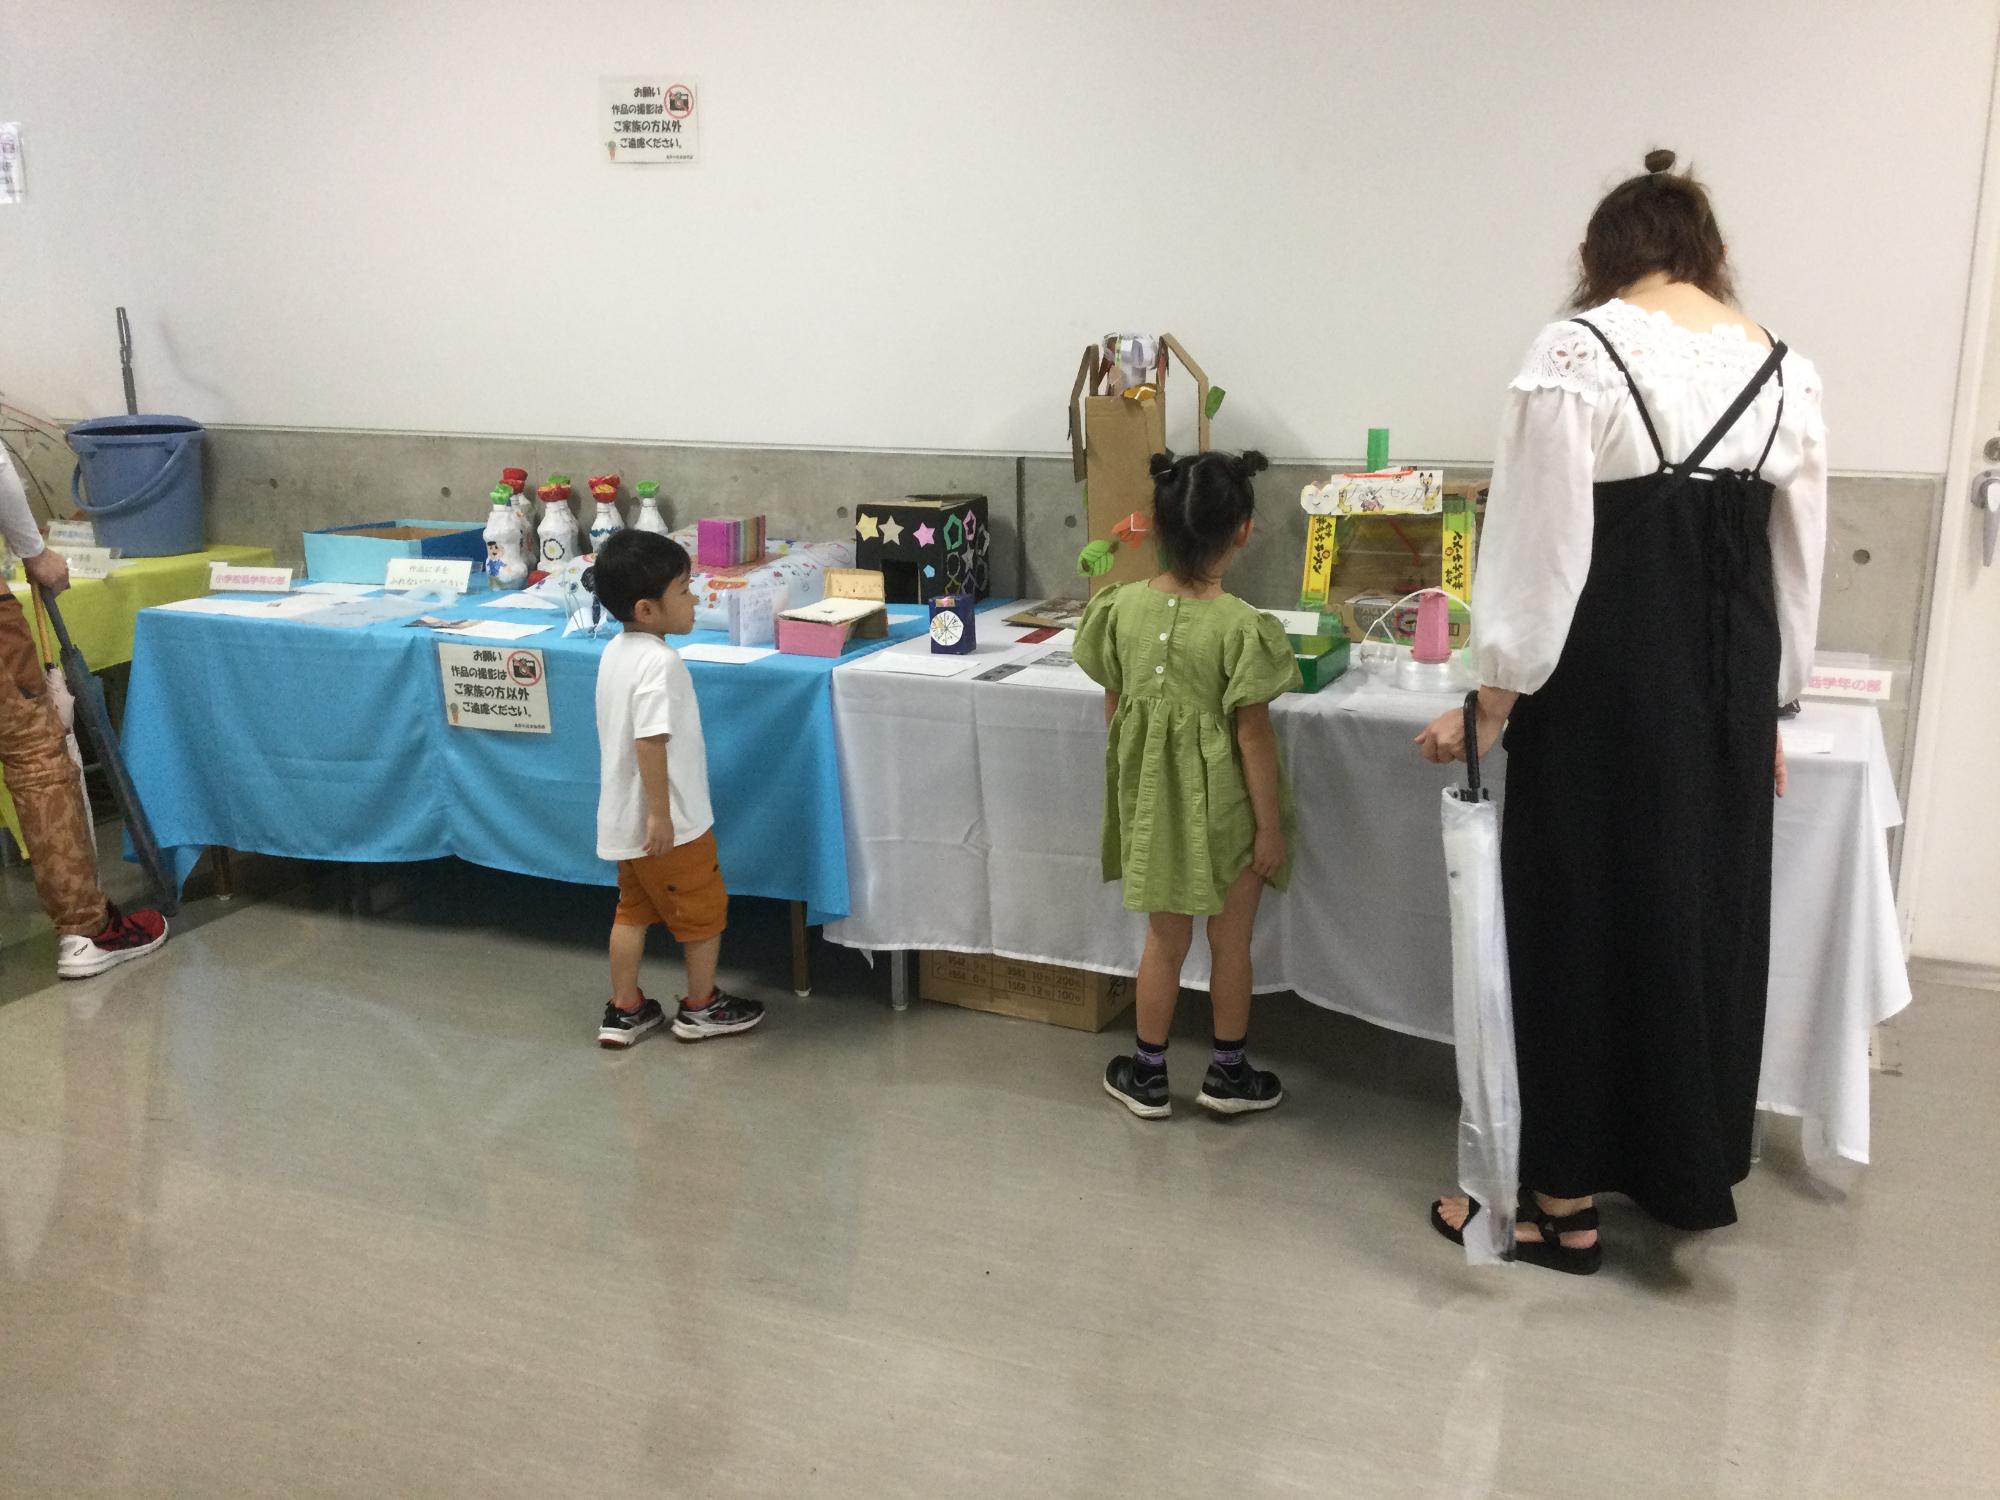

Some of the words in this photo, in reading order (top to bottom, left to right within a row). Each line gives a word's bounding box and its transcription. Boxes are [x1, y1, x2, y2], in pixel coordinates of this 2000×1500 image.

[633, 86, 661, 98] お願い
[611, 103, 664, 115] 作品の撮影は
[613, 120, 682, 133] ご家族の方以外
[620, 137, 682, 149] ご遠慮ください。
[473, 650, 503, 662] お願い
[451, 665, 508, 681] 作品の撮影は
[454, 683, 530, 701] ご家族の方以外
[462, 701, 532, 718] ご遠慮ください。
